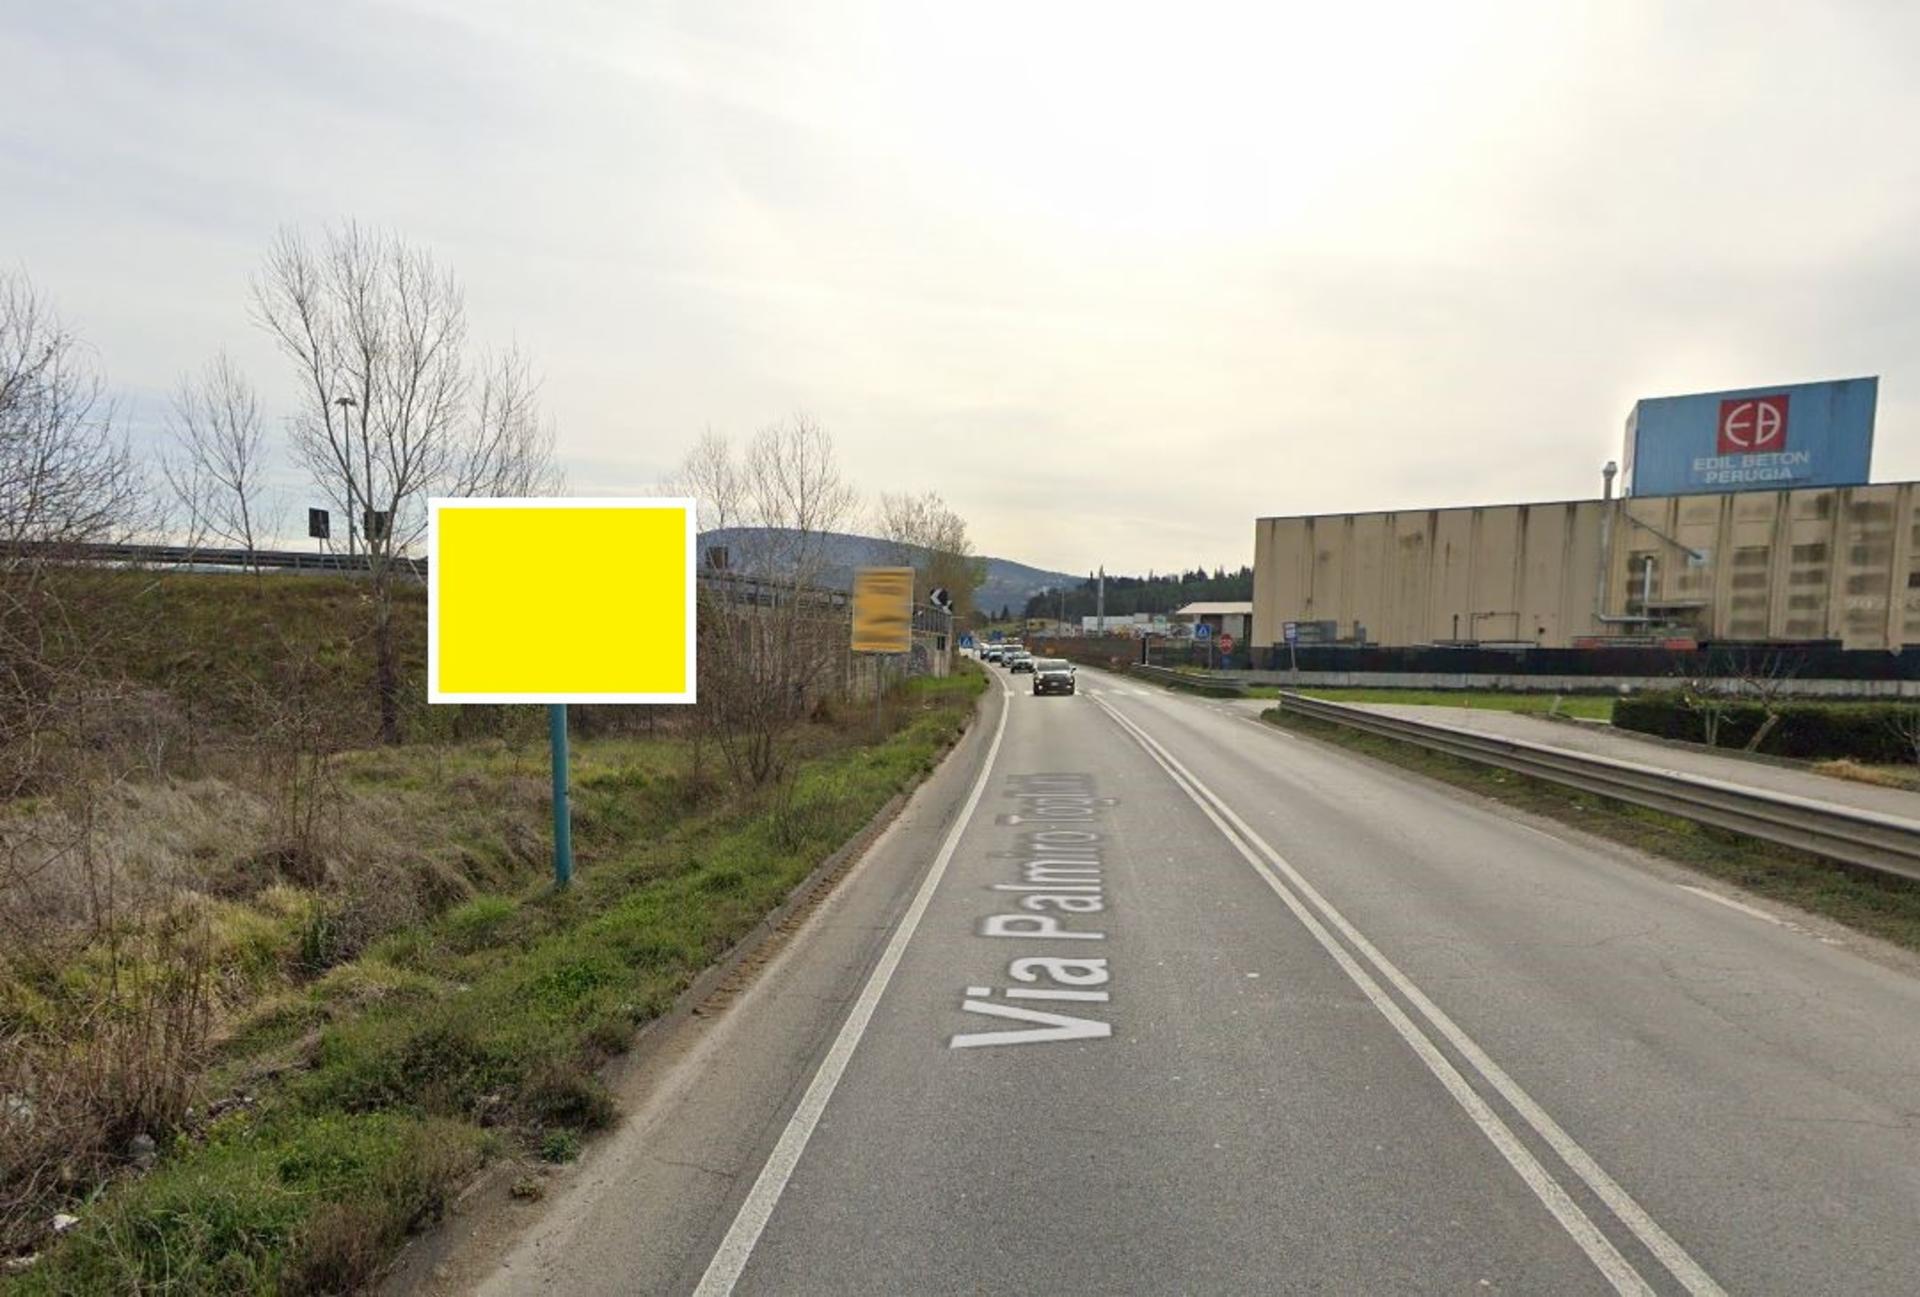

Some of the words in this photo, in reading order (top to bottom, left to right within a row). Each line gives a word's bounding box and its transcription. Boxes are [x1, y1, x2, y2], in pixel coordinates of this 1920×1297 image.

[1693, 456, 1736, 471] EDIL
[1742, 450, 1809, 468] BETON
[1705, 468, 1792, 484] PERUGIA
